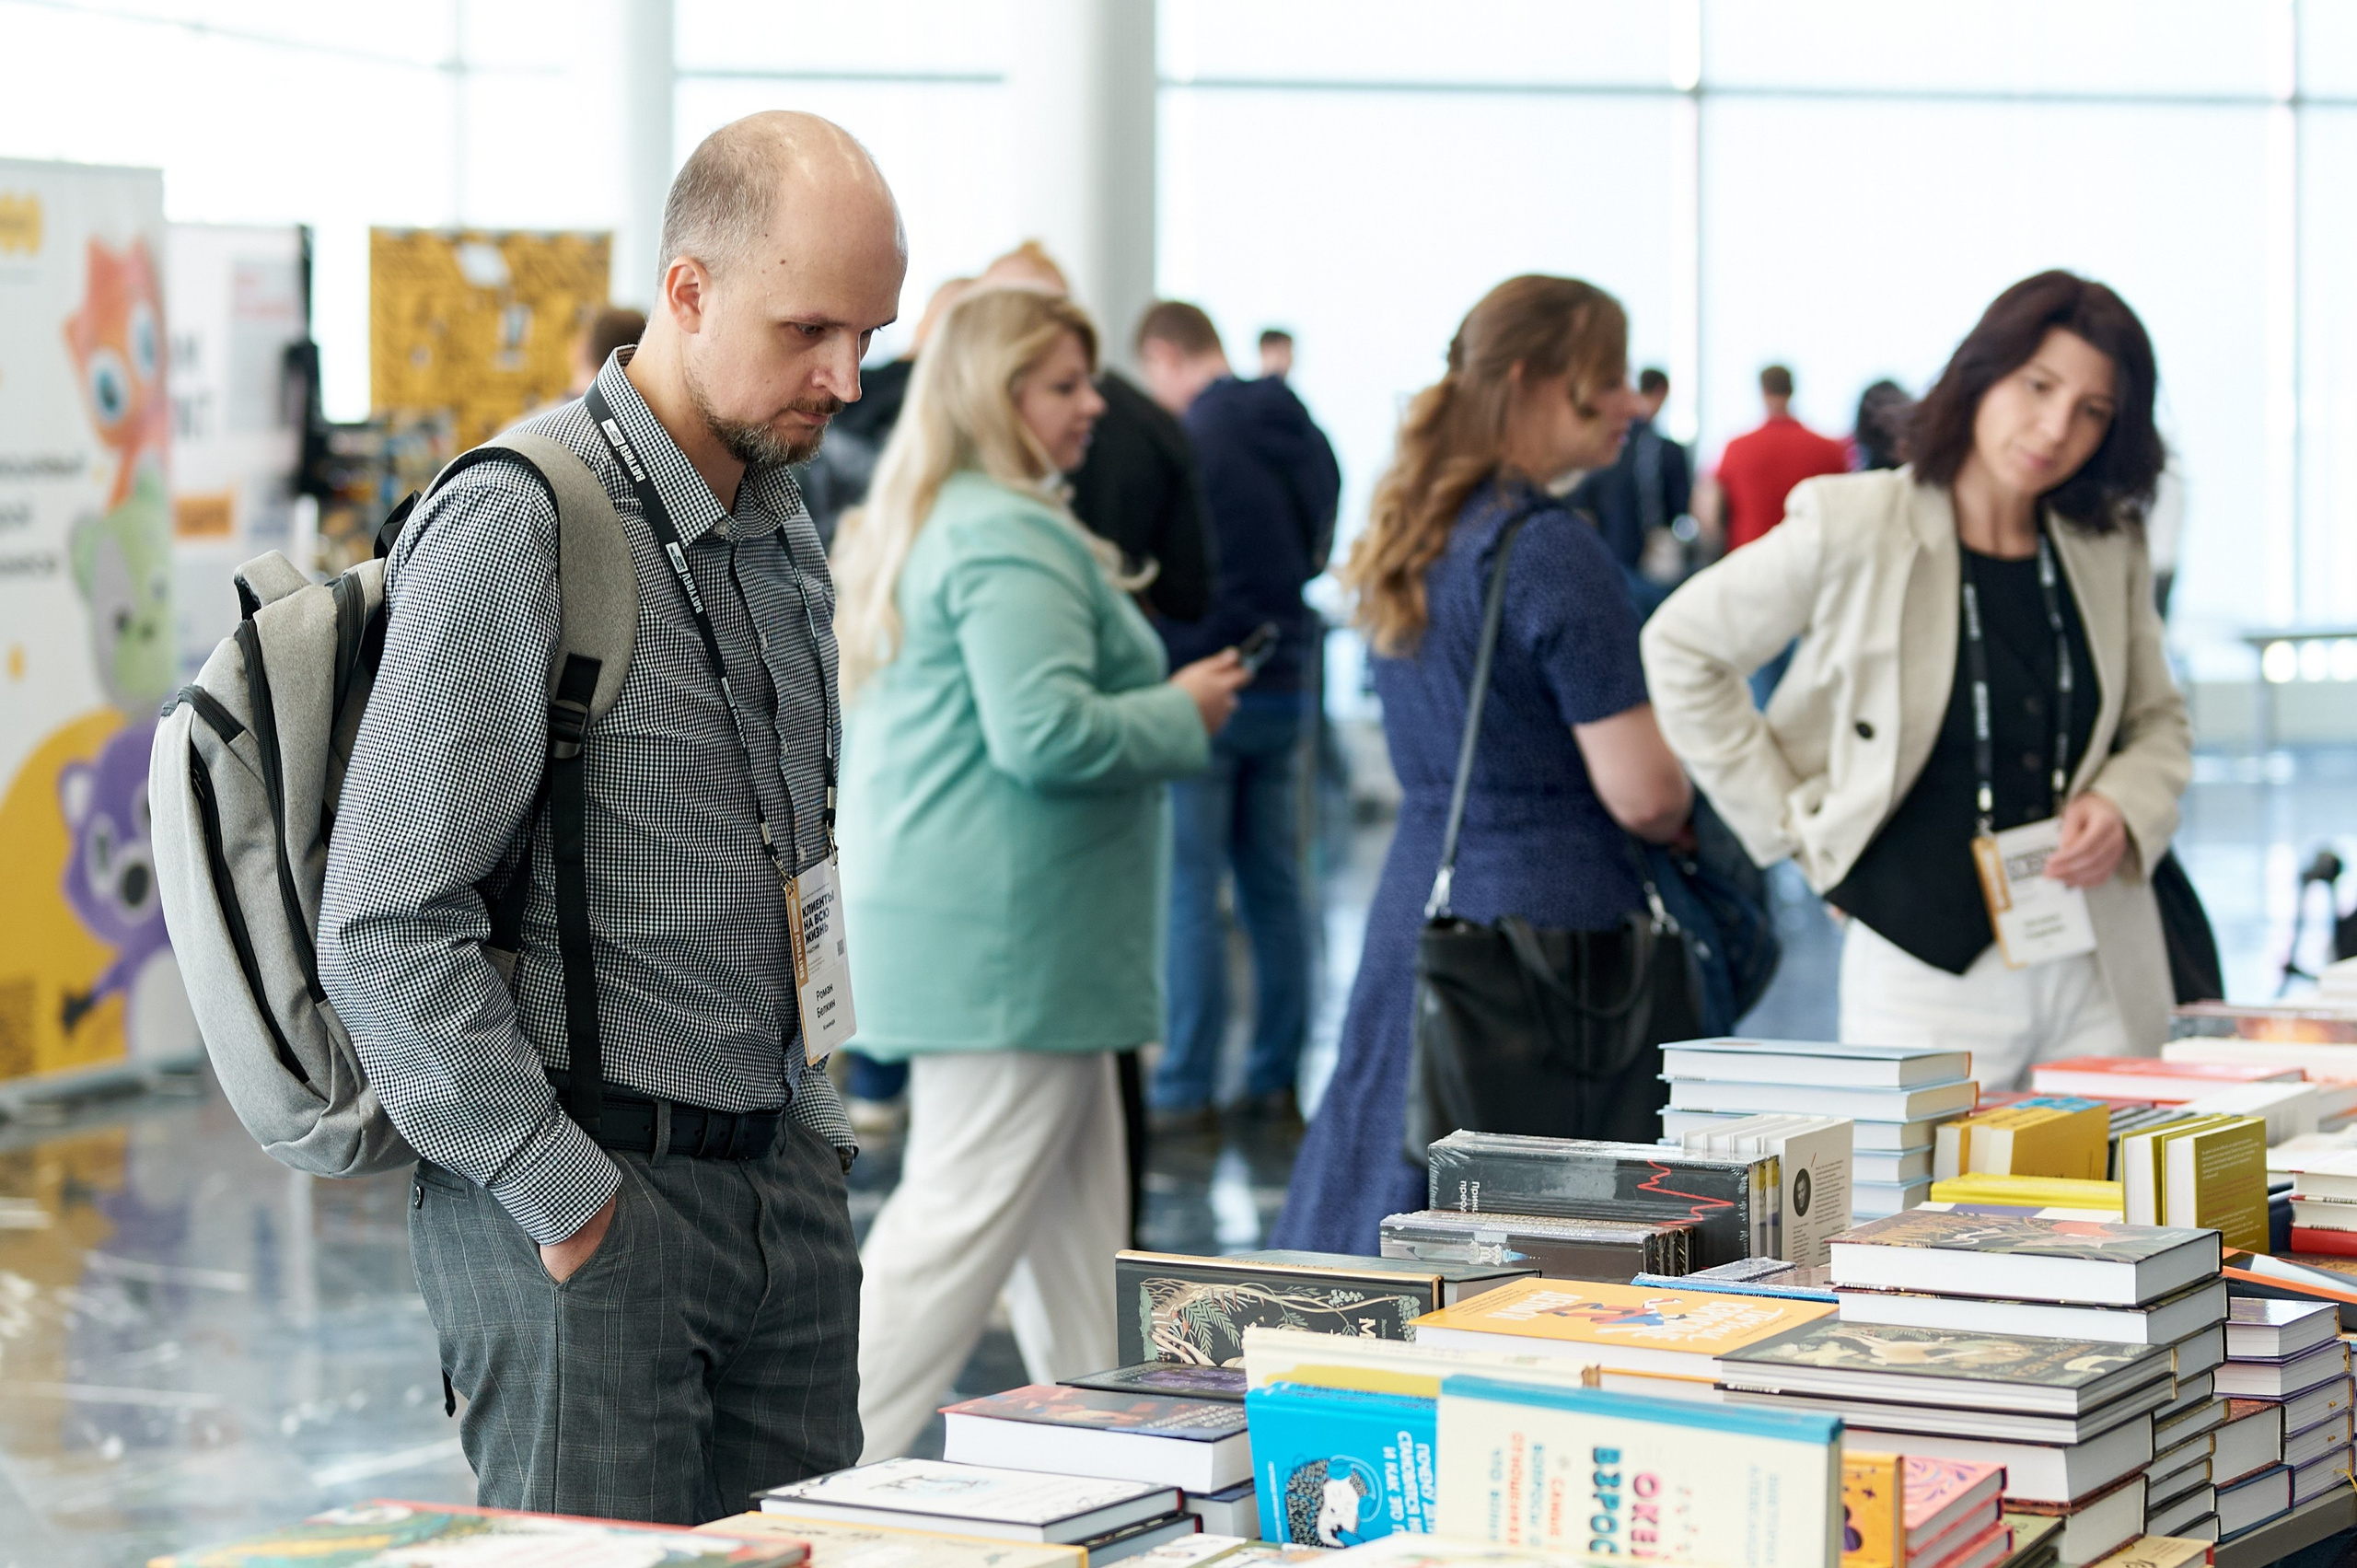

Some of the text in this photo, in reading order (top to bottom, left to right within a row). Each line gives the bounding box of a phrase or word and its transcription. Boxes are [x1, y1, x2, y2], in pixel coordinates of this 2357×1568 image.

[616, 444, 646, 482] BATYREV
[679, 573, 703, 614] BATYREV
[801, 889, 834, 919] КЛИЕНТЫ
[804, 907, 830, 932] НА ВСЮ
[805, 923, 829, 945] ЖИЗНЬ
[816, 983, 833, 1001] Роман
[1383, 1446, 1398, 1459] И
[1384, 1462, 1400, 1493] КАК
[1397, 1431, 1422, 1515] СТАНОВЯТСЯ
[1415, 1443, 1434, 1501] ПОЧЕМУ
[1387, 1495, 1404, 1521] ЭТО
